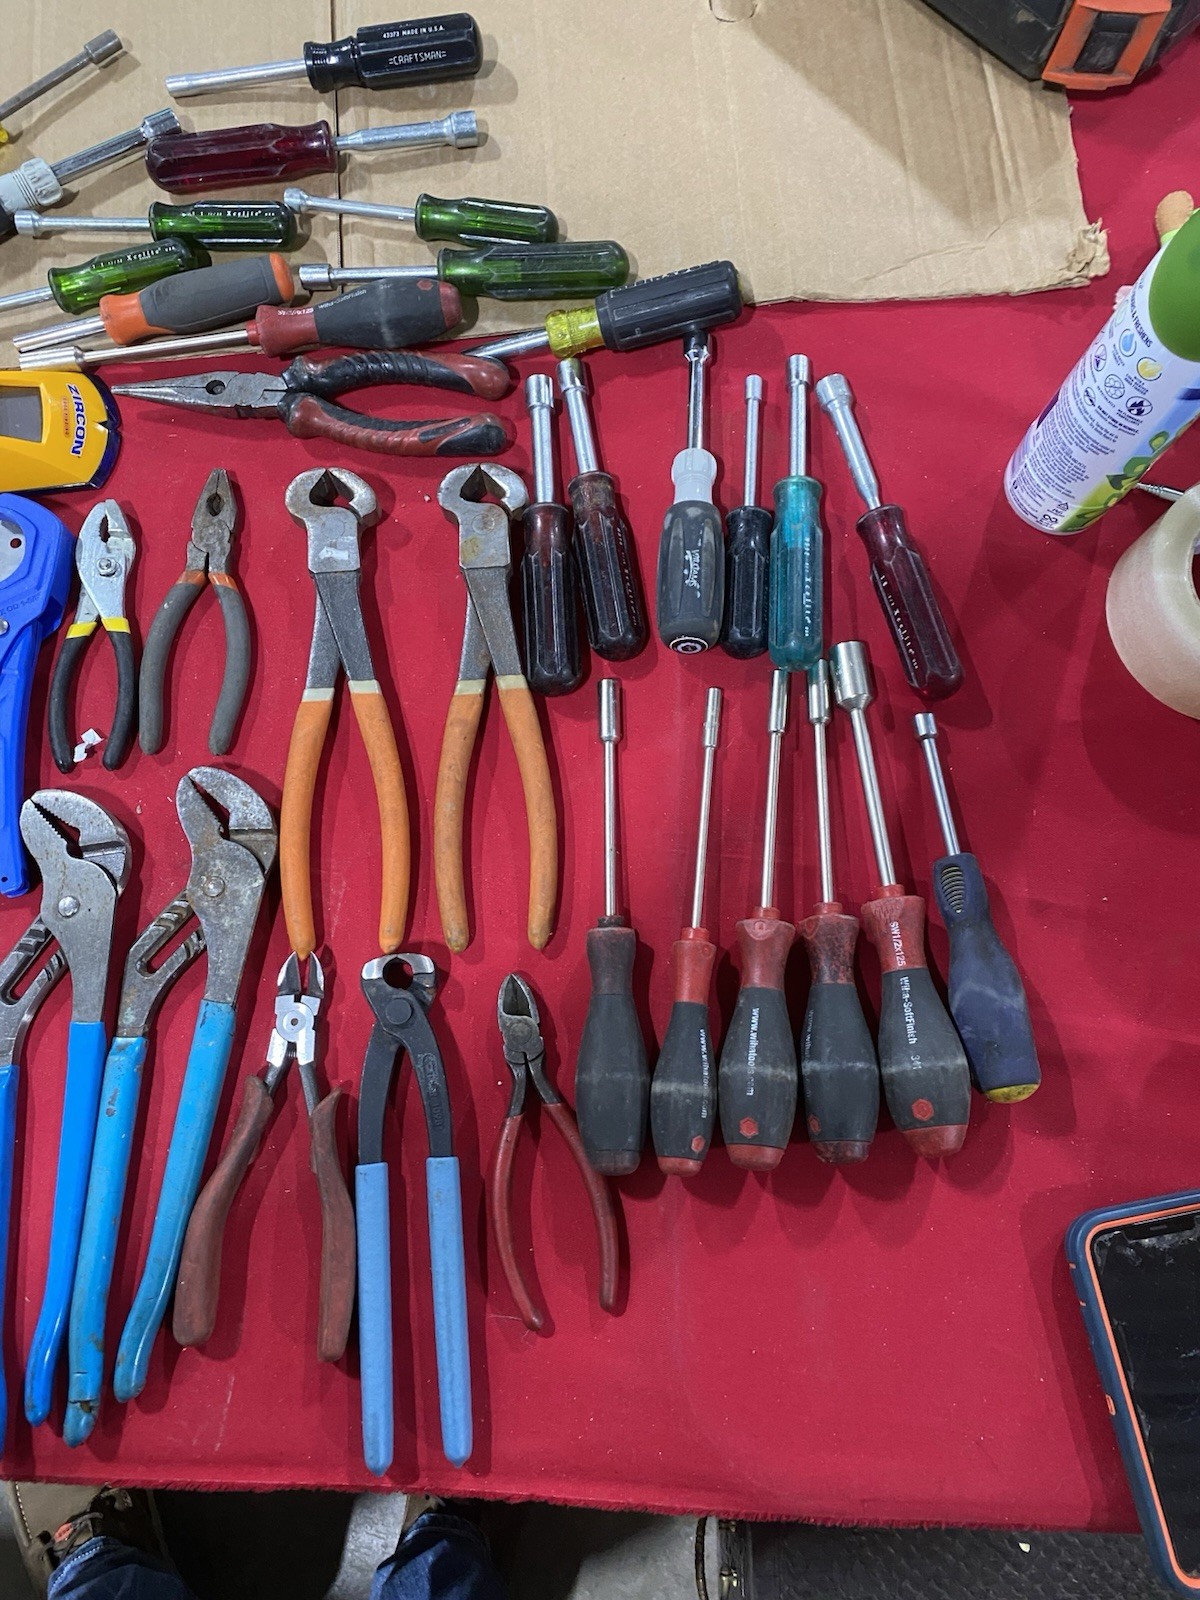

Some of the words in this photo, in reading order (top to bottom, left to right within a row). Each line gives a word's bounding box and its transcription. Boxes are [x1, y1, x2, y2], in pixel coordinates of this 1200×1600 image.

[402, 29, 419, 37] MADE
[419, 27, 427, 35] IN
[428, 25, 446, 33] U.S.A.
[1133, 316, 1153, 348] FRESHENS
[66, 384, 87, 456] ZIRCON
[890, 921, 907, 967] SW1/2x125
[900, 976, 918, 1045] Wiha-SoftFinish
[700, 1028, 710, 1119] www.wihatoo.com
